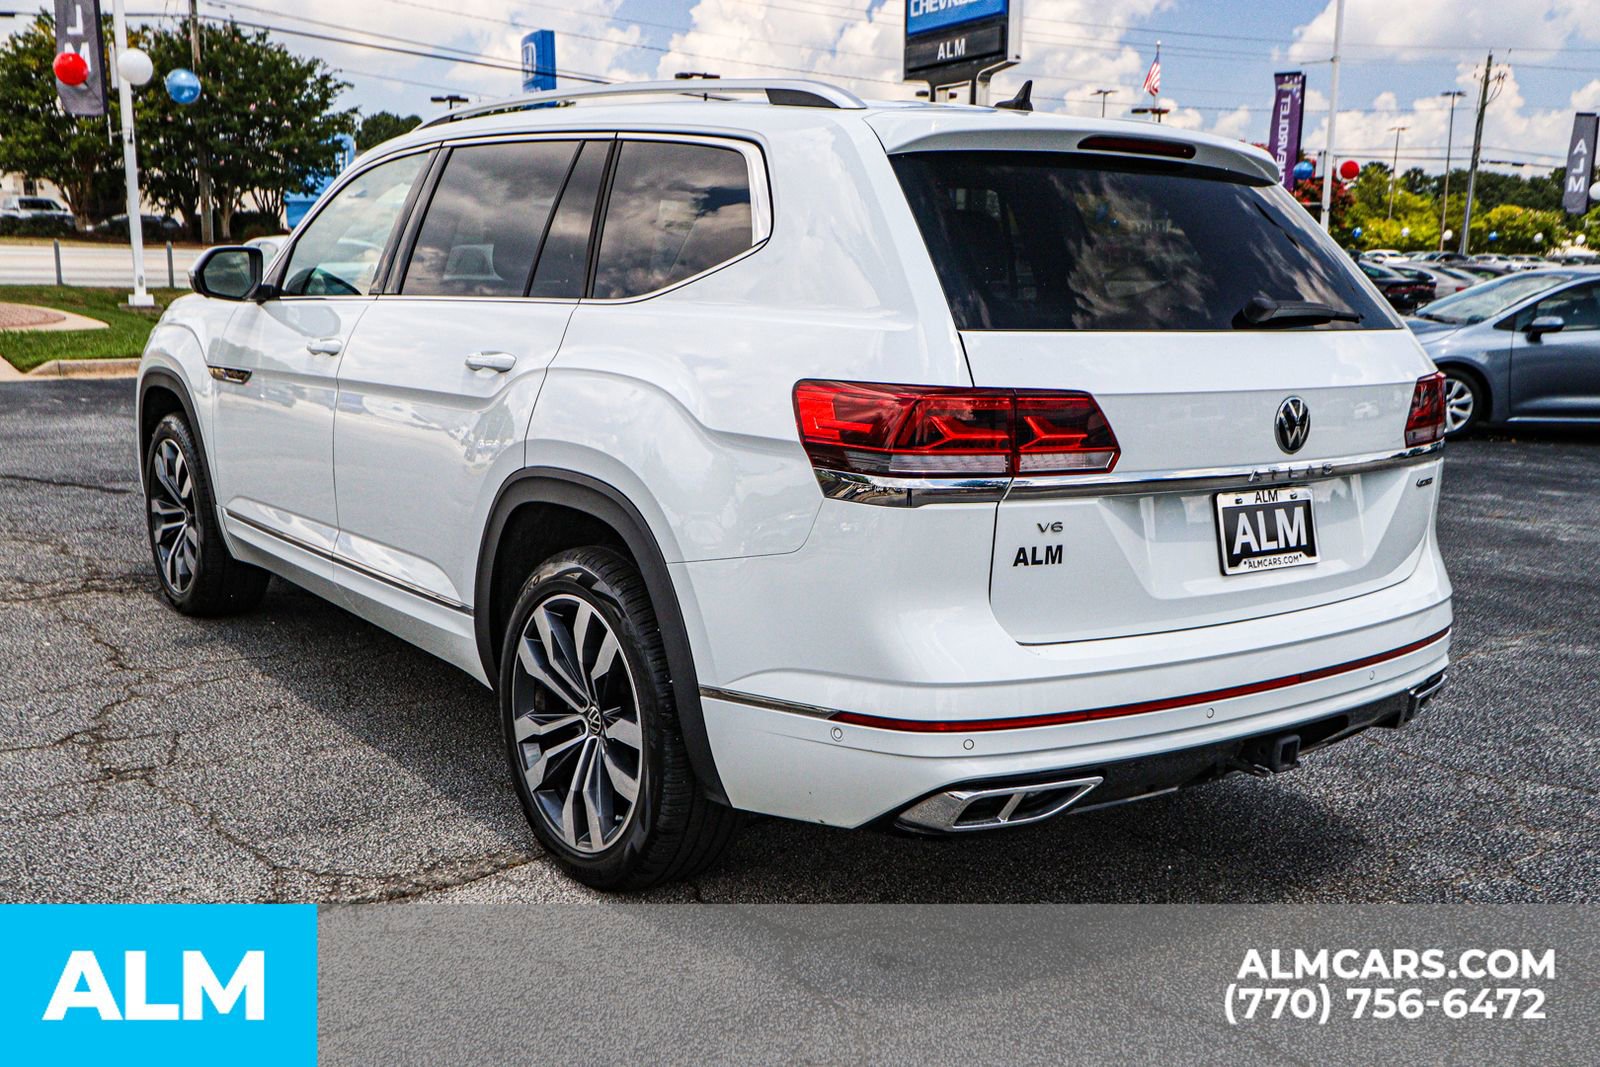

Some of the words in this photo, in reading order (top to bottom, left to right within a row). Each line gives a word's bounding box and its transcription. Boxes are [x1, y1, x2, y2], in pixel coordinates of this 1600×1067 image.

[937, 38, 966, 60] ALM
[1255, 490, 1278, 503] ALM
[1037, 521, 1064, 534] V6
[1232, 506, 1308, 555] ALM
[1013, 544, 1063, 567] ALM
